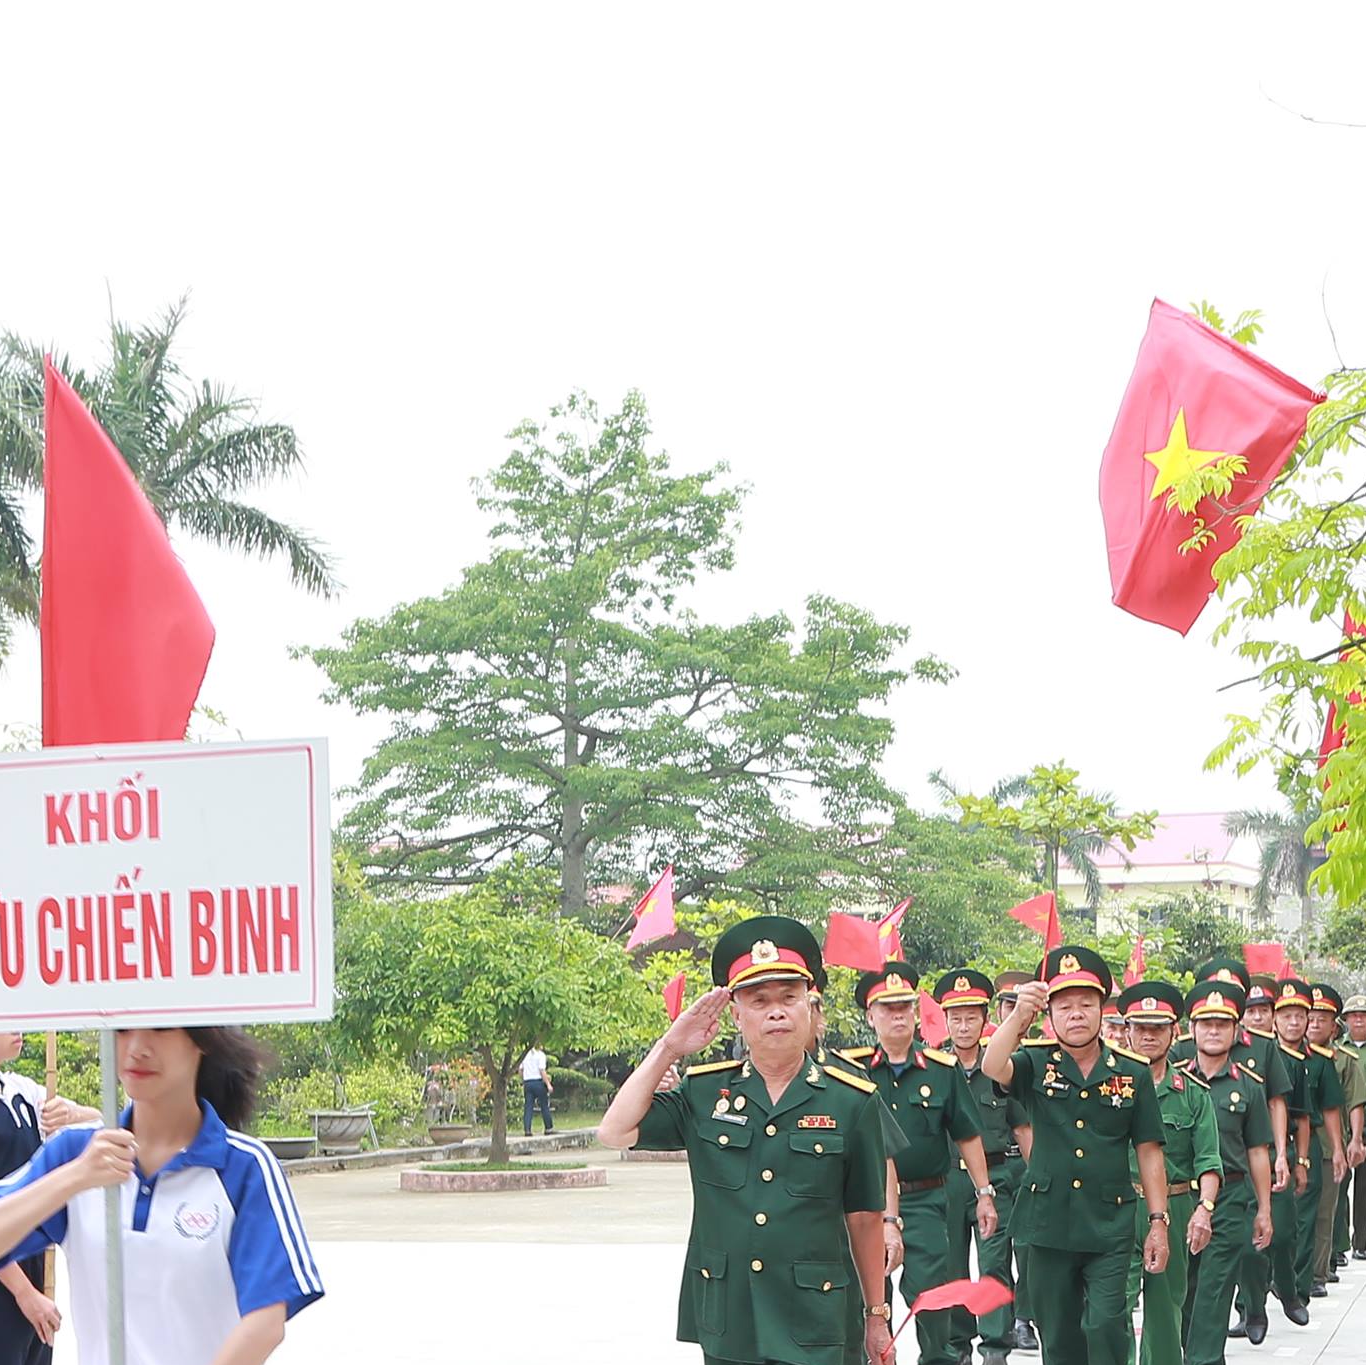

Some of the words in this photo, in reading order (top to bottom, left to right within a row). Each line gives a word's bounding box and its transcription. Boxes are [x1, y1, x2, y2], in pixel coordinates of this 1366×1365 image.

[44, 770, 160, 846] KHỐI
[37, 867, 174, 986] CHIẾN
[189, 884, 301, 977] BINH
